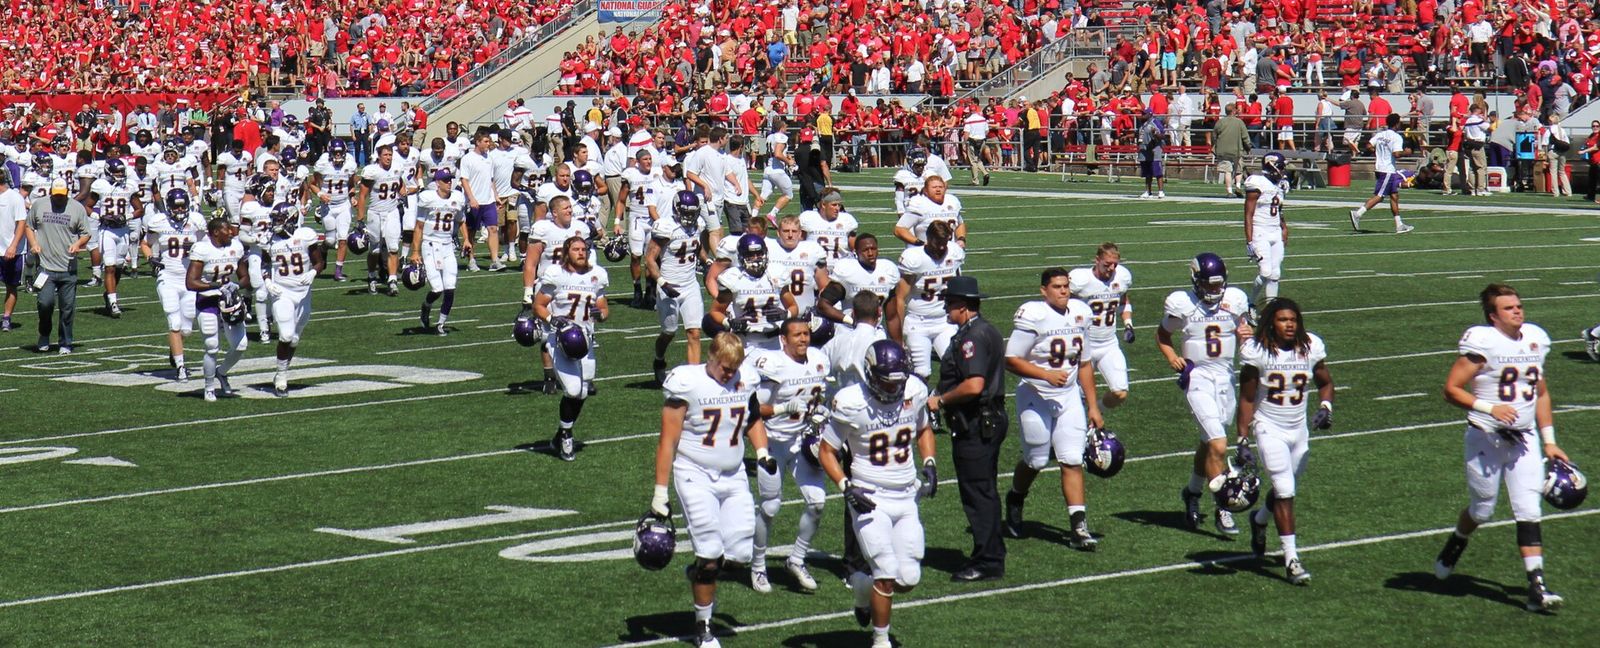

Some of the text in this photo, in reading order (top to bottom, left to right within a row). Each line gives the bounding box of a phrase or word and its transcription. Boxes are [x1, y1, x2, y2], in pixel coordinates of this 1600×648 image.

[600, 1, 636, 10] NATIONAL
[327, 180, 344, 194] 14
[276, 252, 304, 277] 39
[567, 293, 592, 321] 71
[1047, 336, 1083, 368] 93
[1205, 325, 1221, 357] 6
[1267, 373, 1308, 406] 23
[1498, 366, 1539, 402] 83
[702, 406, 746, 447] 77
[869, 427, 912, 467] 89
